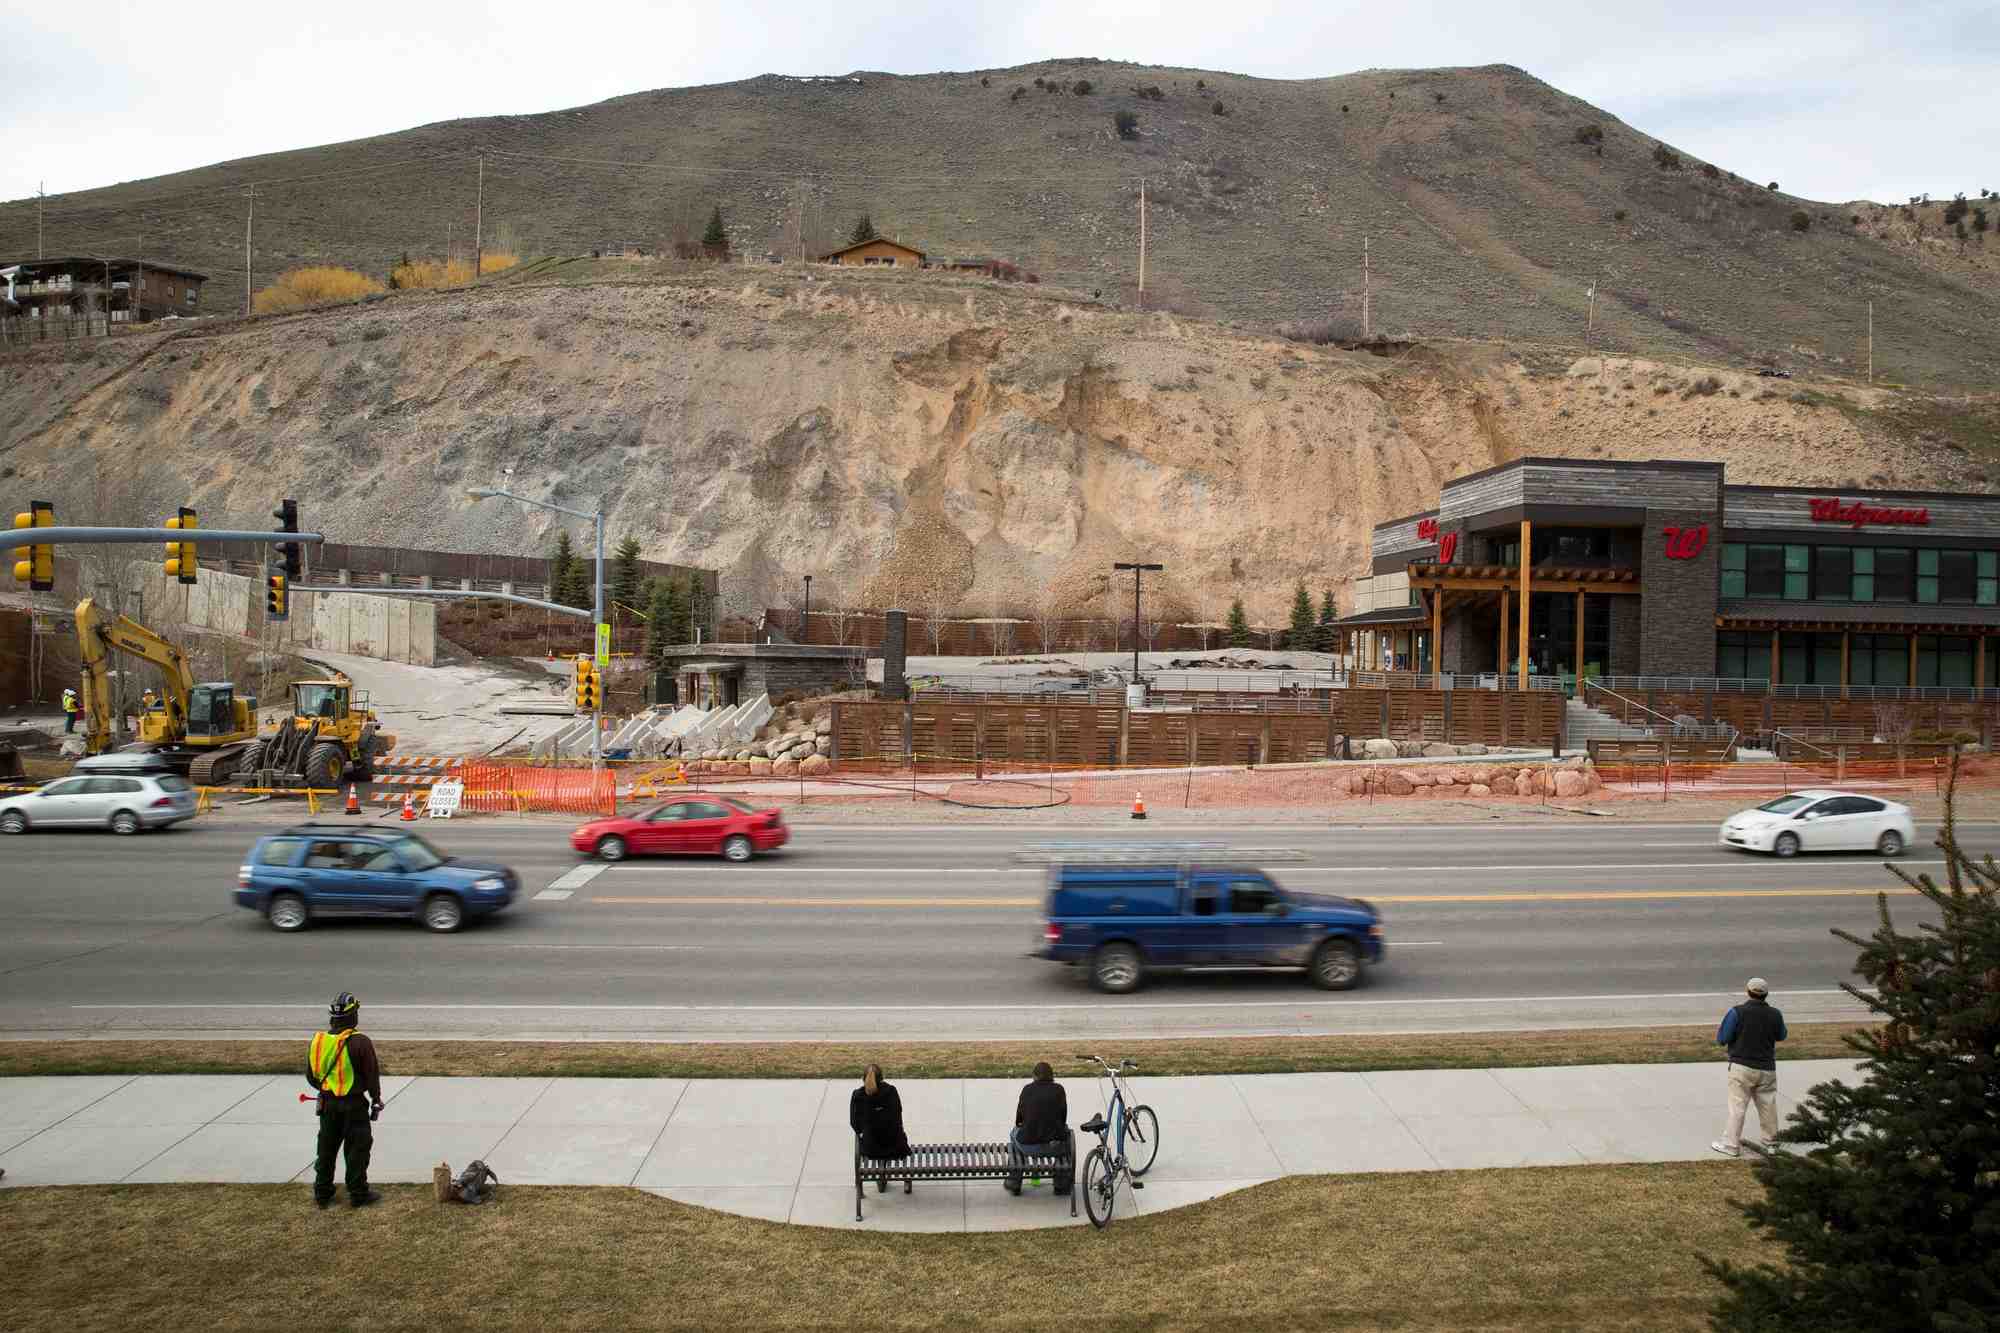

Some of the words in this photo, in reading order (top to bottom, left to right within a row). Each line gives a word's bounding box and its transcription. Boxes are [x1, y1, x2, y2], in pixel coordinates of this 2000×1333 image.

[1808, 496, 1929, 528] Walgreens
[437, 787, 456, 796] ROAD
[431, 797, 458, 806] CLOSED
